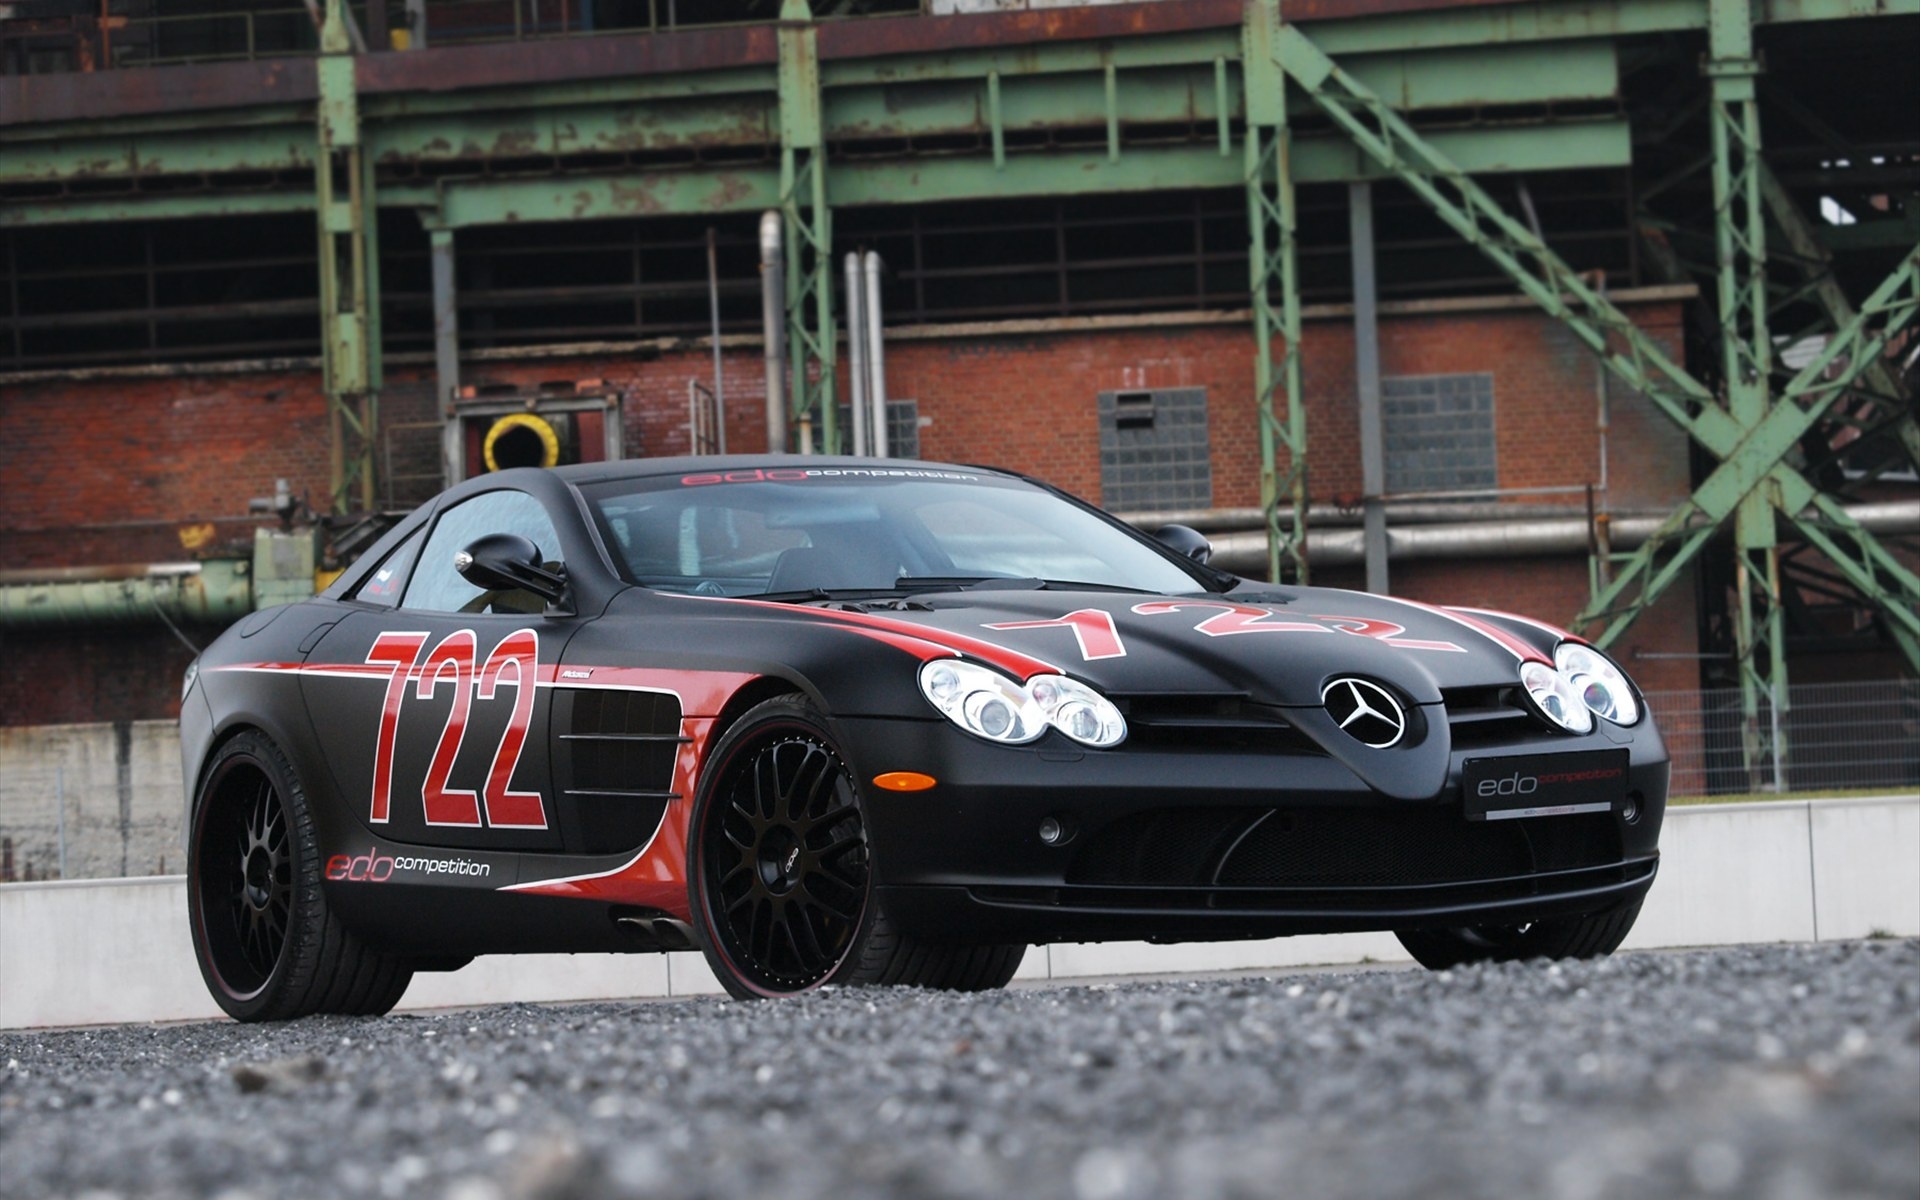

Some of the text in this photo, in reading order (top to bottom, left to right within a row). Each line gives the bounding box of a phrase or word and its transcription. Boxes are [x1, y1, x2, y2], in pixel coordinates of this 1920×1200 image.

[680, 468, 979, 486] edo competition
[364, 628, 549, 830] 722
[1477, 767, 1622, 797] edo competition
[325, 846, 491, 882] edo competition
